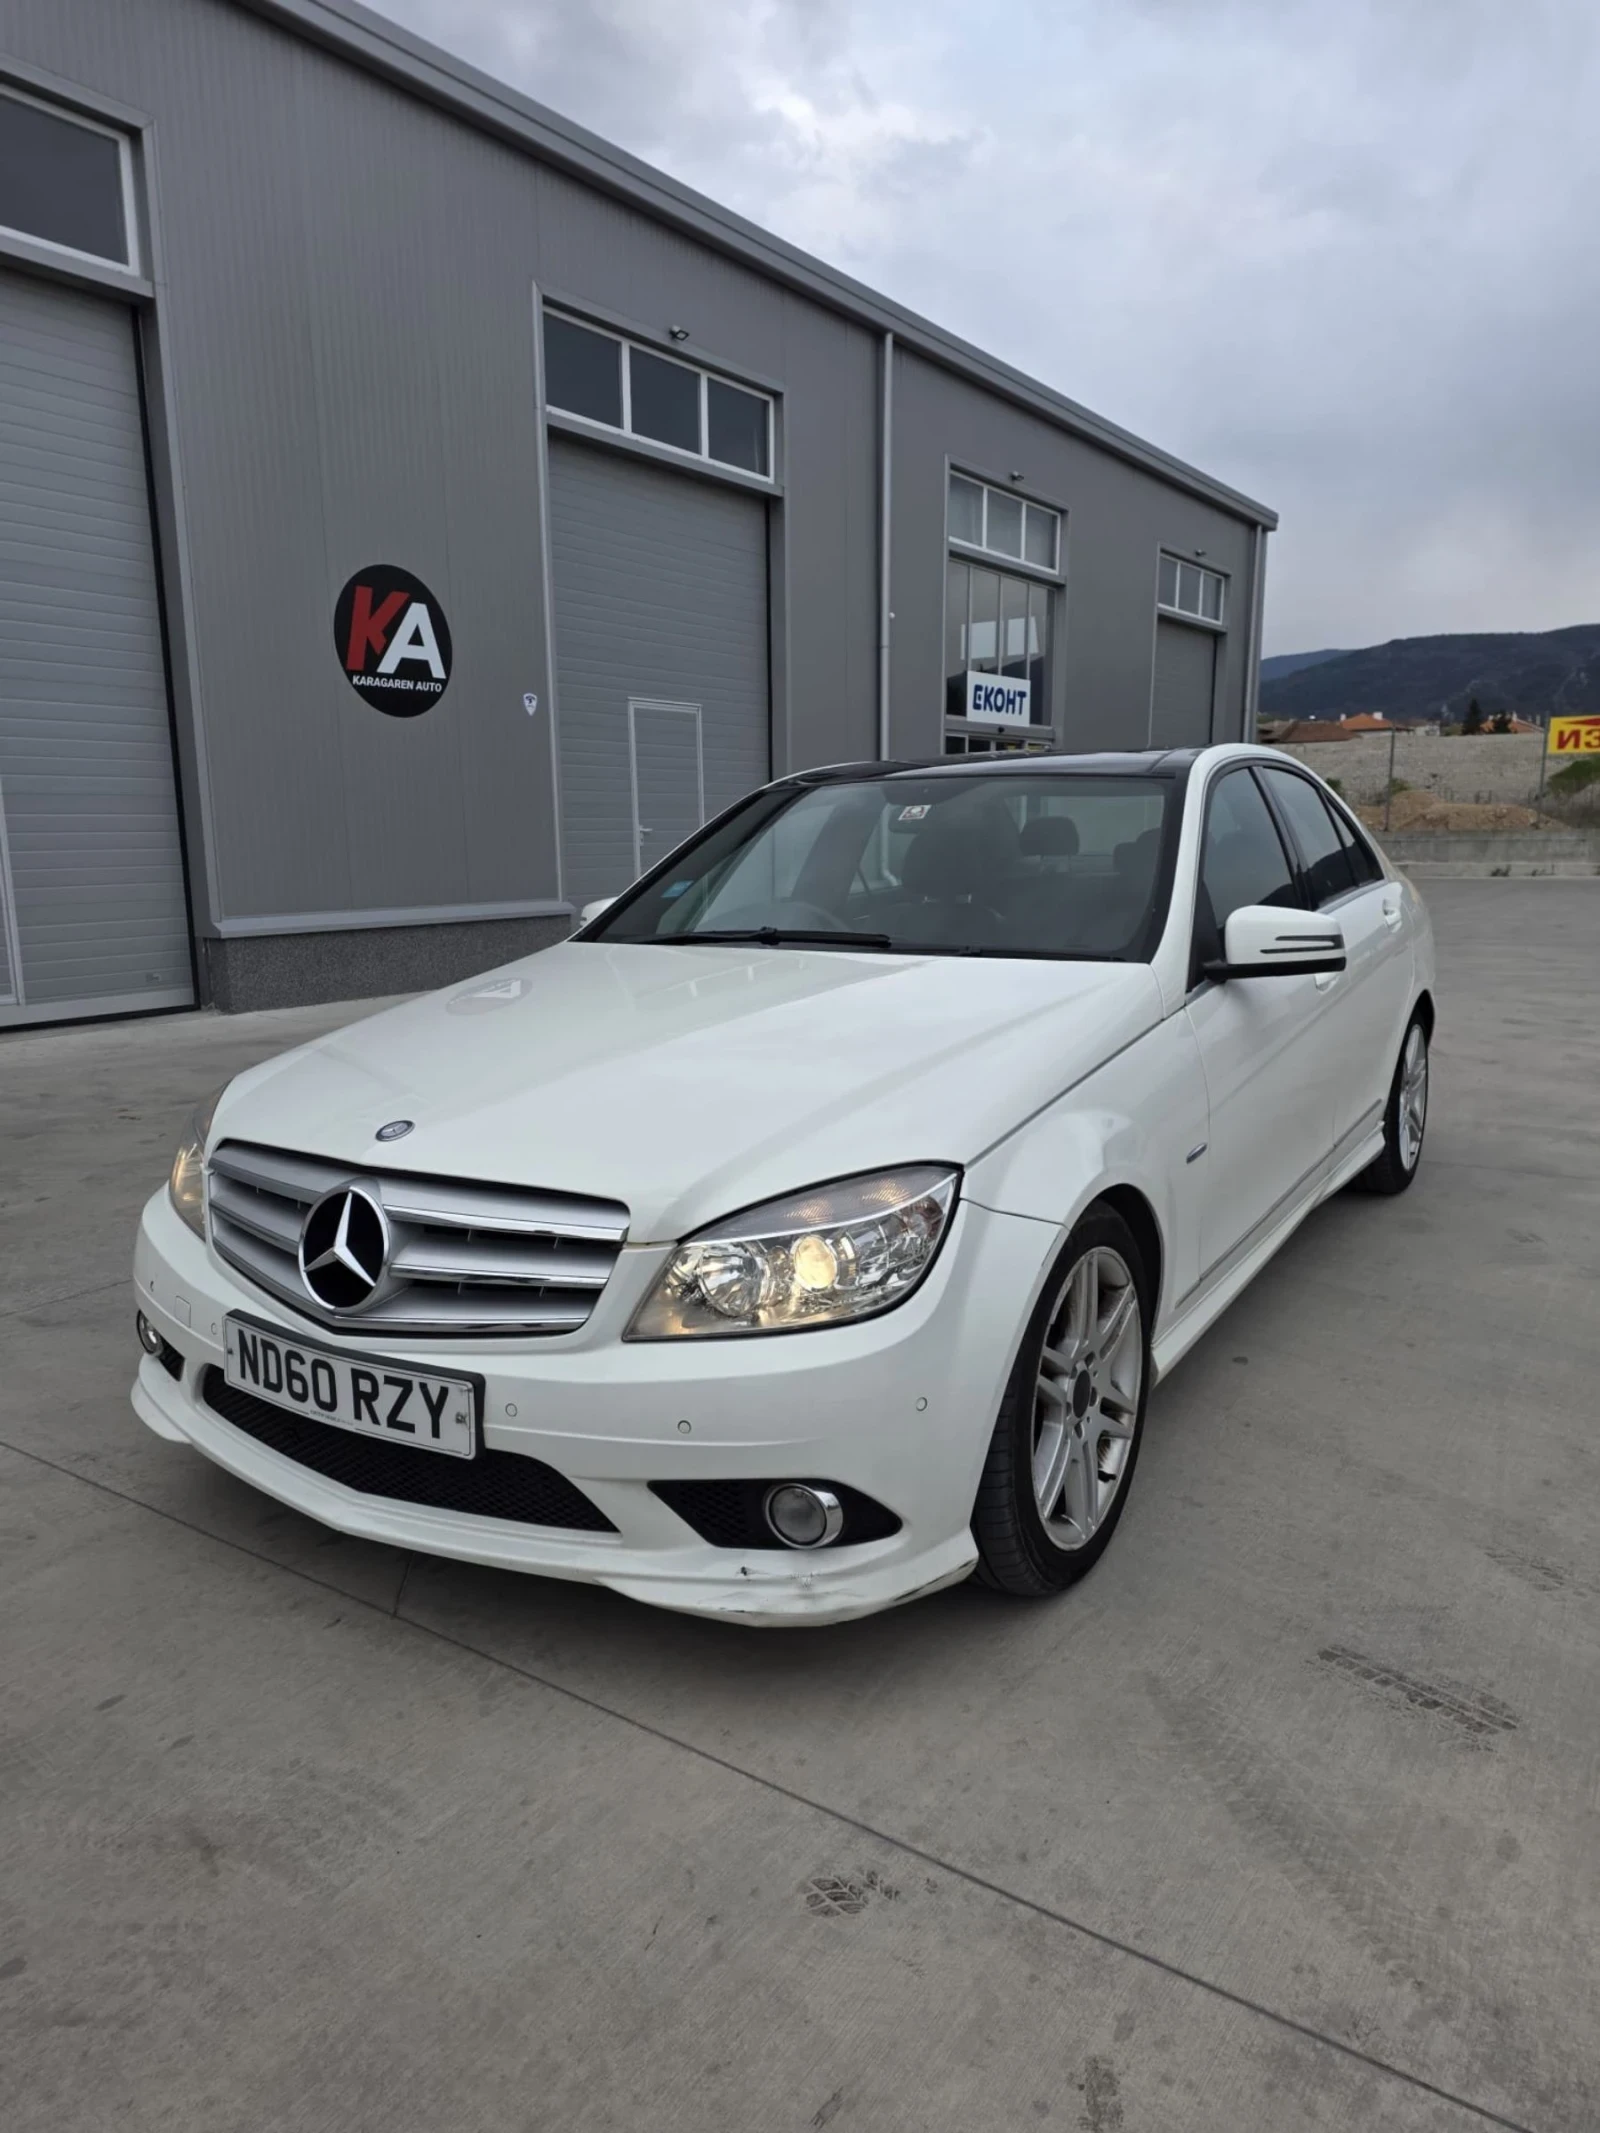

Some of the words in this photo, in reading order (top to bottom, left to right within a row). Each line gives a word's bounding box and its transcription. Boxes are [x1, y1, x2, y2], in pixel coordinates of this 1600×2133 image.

[346, 585, 446, 679] KA
[352, 675, 414, 690] KARAGAREN
[415, 681, 443, 693] AUTO
[973, 684, 1027, 715] ЕКОНТ
[238, 1328, 338, 1413] ND60
[350, 1367, 449, 1440] RZY
